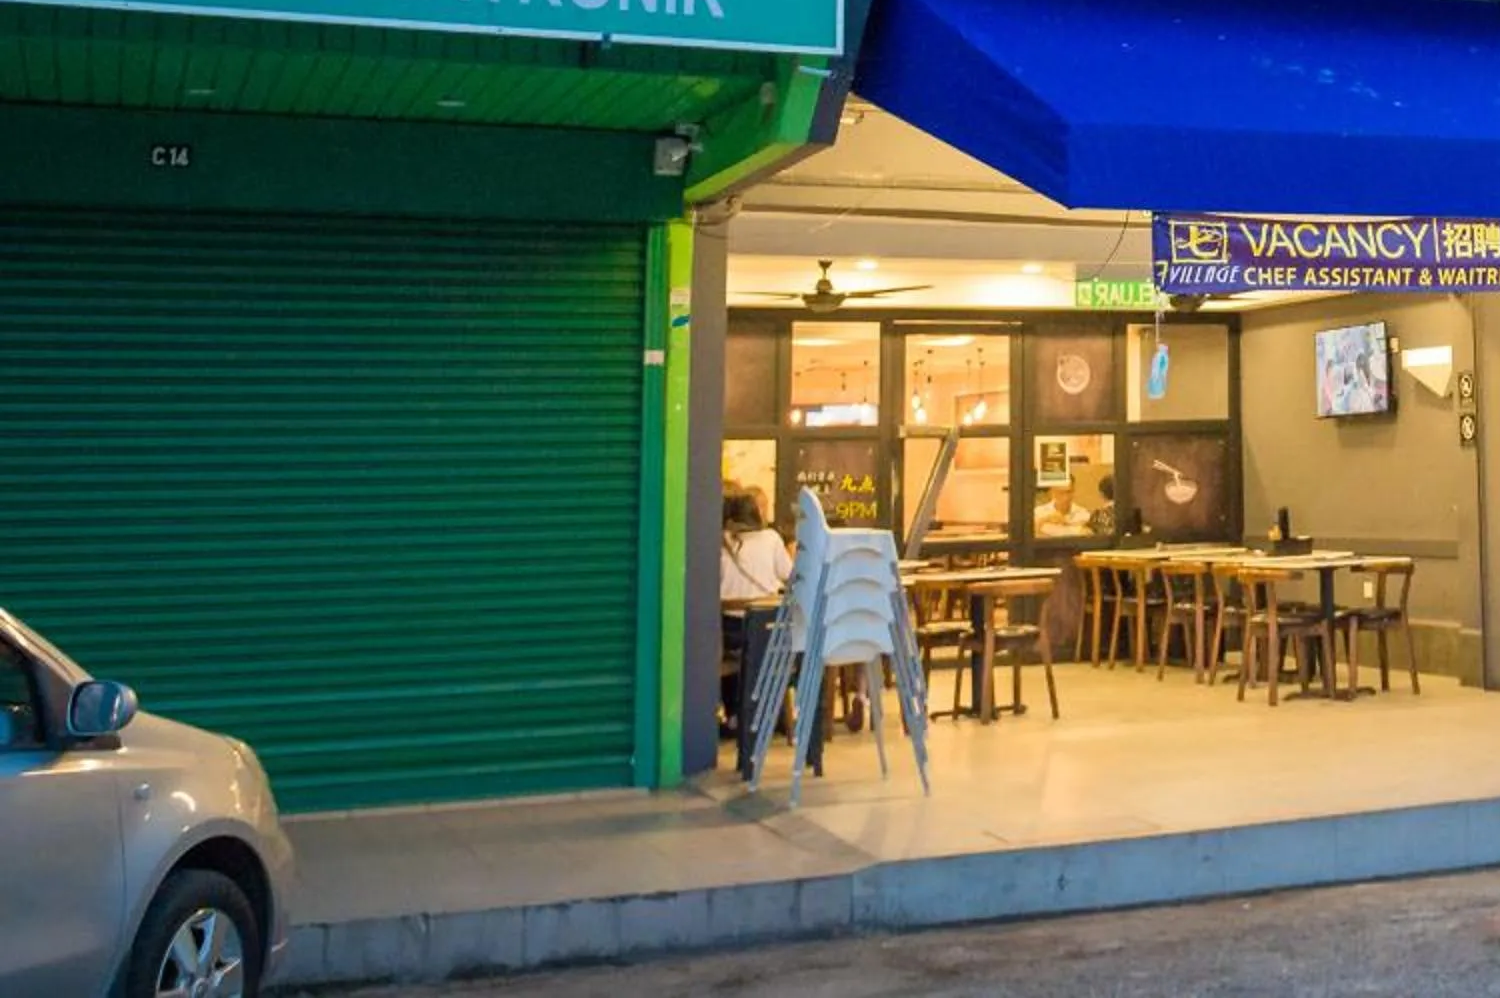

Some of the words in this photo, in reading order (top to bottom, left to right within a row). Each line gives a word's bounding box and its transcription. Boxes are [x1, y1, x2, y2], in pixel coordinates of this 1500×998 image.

[1239, 221, 1430, 259] VACANCY
[1169, 265, 1240, 284] VILLAGE
[1244, 267, 1297, 286] CHEF
[1304, 267, 1414, 286] ASSISTANT
[1419, 267, 1432, 286] &
